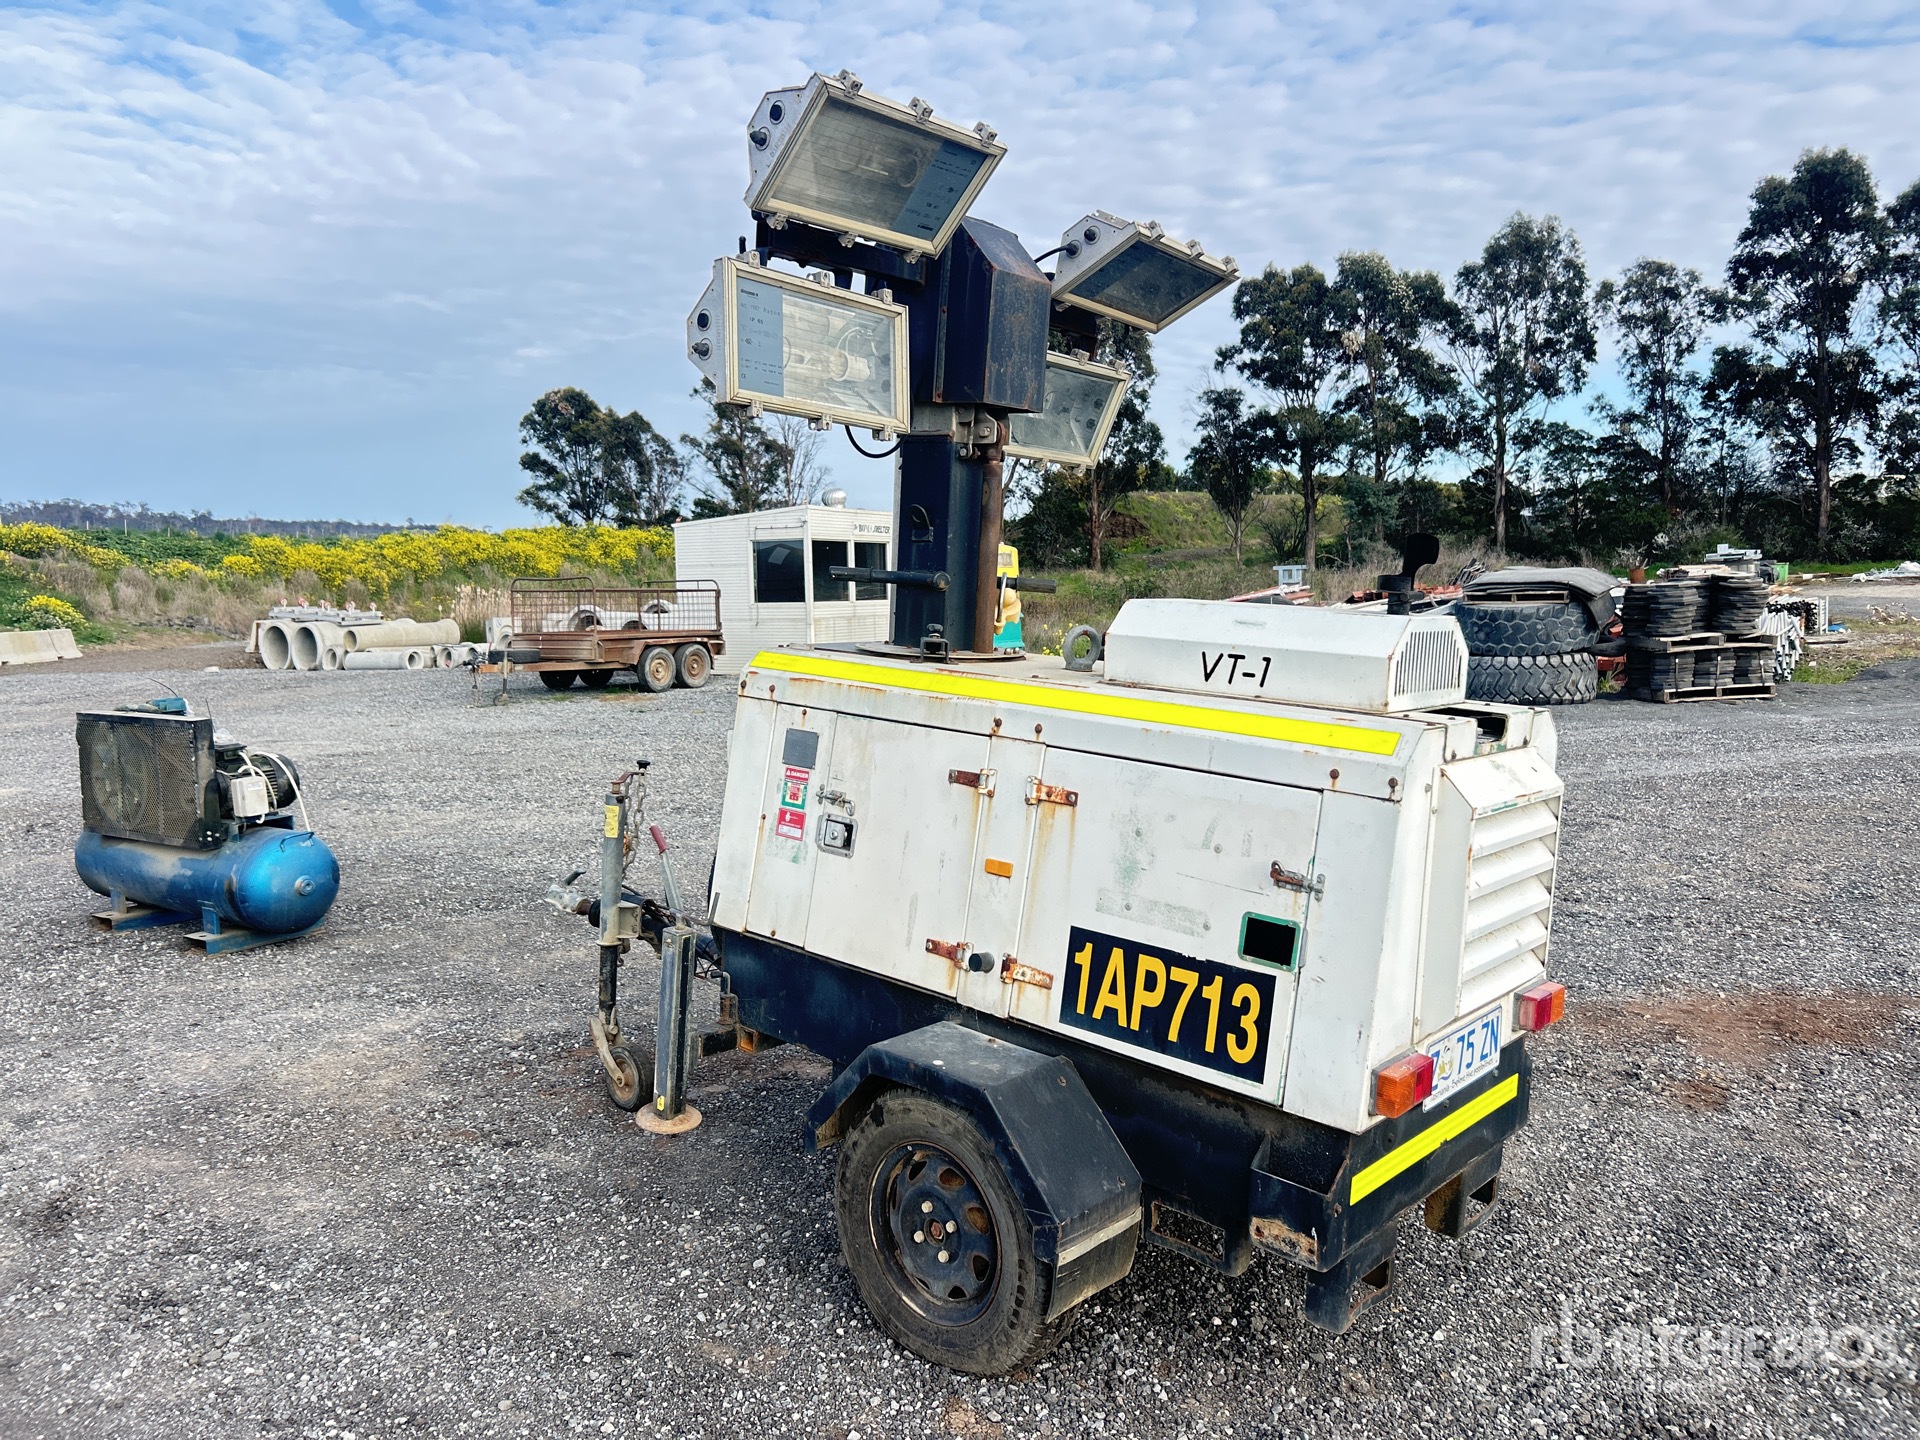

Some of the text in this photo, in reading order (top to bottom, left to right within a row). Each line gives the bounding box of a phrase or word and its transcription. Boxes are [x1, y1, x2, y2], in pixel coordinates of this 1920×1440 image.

[1201, 651, 1272, 688] VT-1
[790, 771, 808, 779] DANGER
[1074, 942, 1261, 1065] 1AP713
[1457, 1028, 1475, 1074] 75
[1480, 1016, 1499, 1061] ZN
